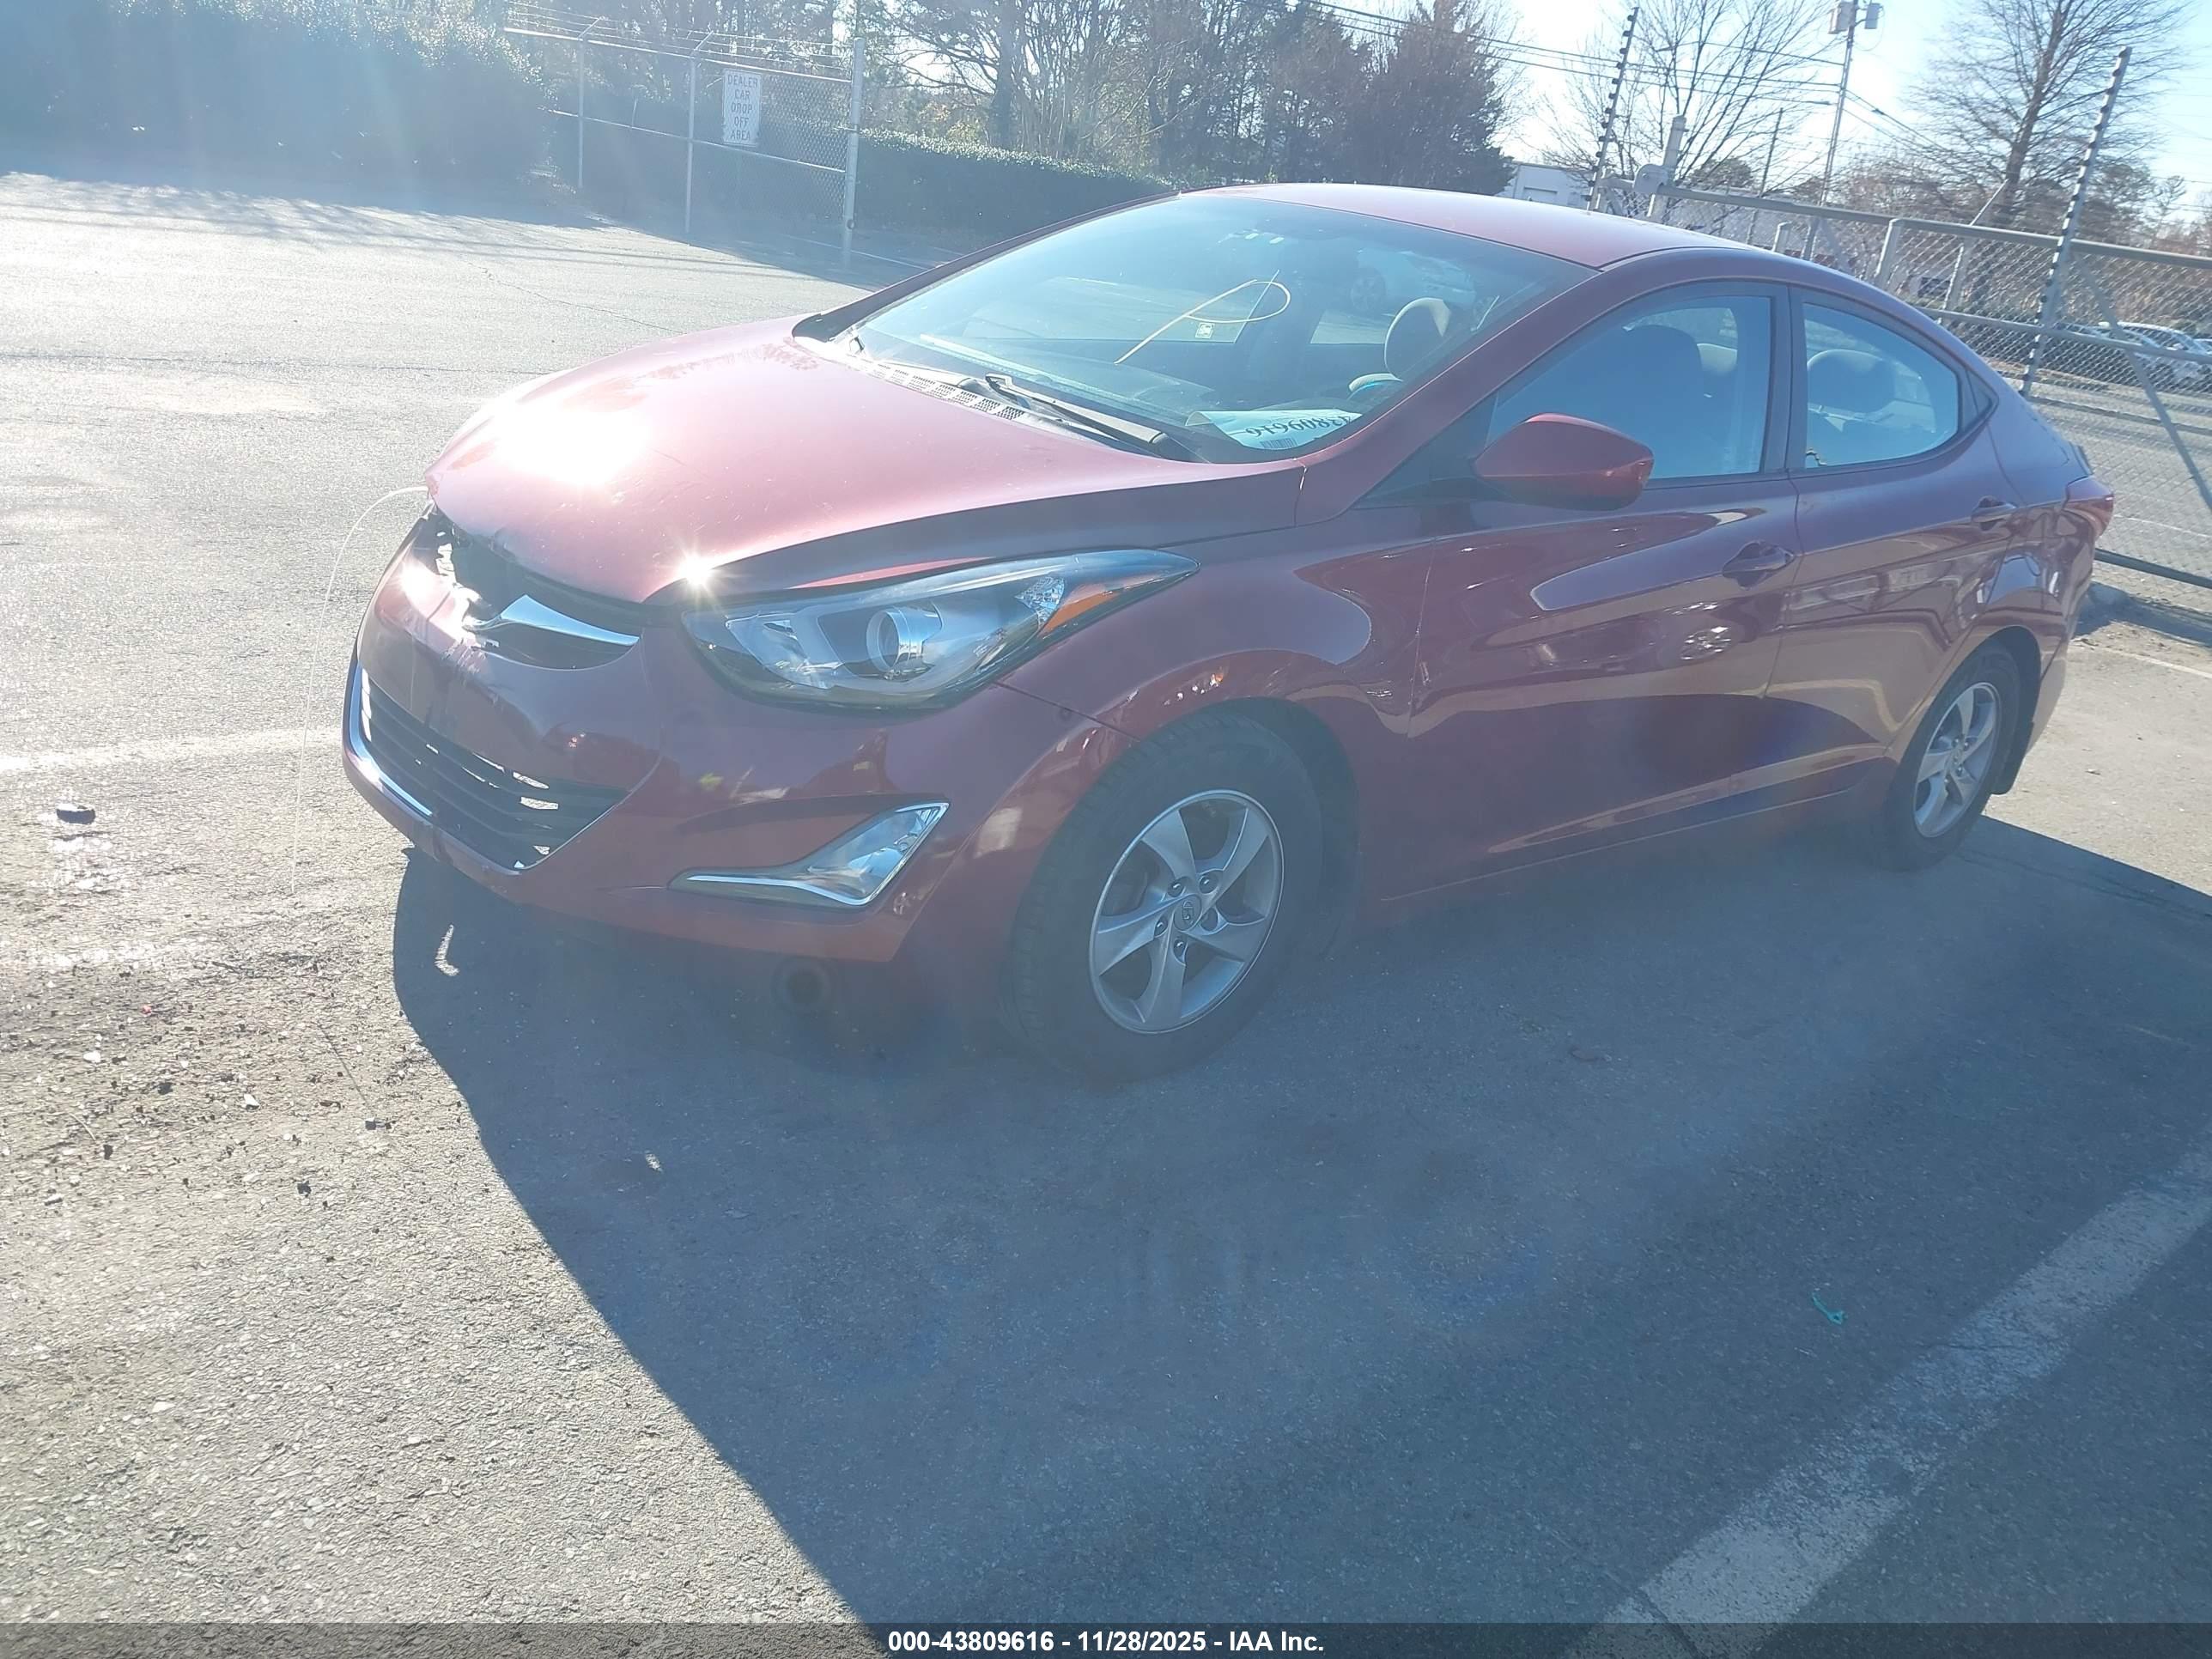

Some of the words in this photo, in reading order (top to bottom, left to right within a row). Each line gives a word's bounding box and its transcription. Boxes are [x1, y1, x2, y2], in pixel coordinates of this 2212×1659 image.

[727, 74, 758, 88] DEALER
[734, 88, 750, 100] CAR
[731, 102, 753, 114] DROP
[733, 116, 749, 128] OFF
[730, 130, 750, 141] AREA
